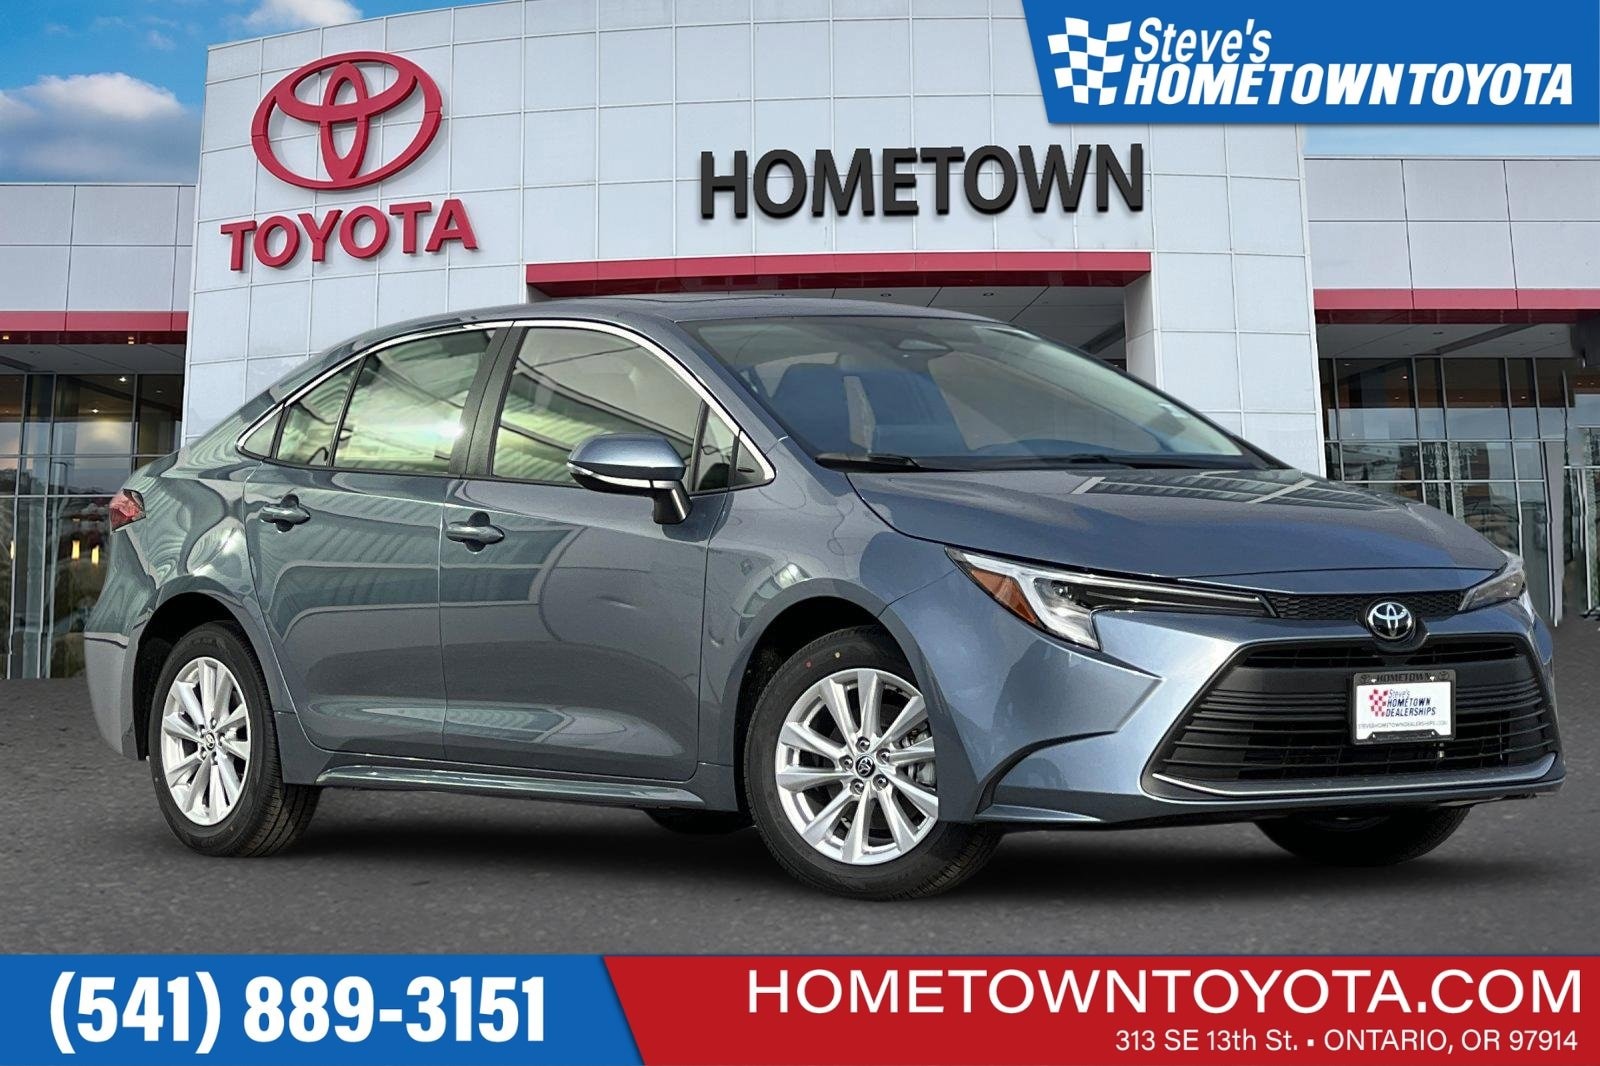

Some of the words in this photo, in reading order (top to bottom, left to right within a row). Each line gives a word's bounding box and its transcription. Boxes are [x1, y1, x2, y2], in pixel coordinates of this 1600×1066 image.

[700, 143, 1144, 219] HOMETOWN
[220, 198, 479, 271] TOYOTA
[1377, 672, 1432, 682] HOMETOWN
[1386, 697, 1430, 708] HOMETOWN
[1386, 707, 1436, 717] DEALERSHIPS
